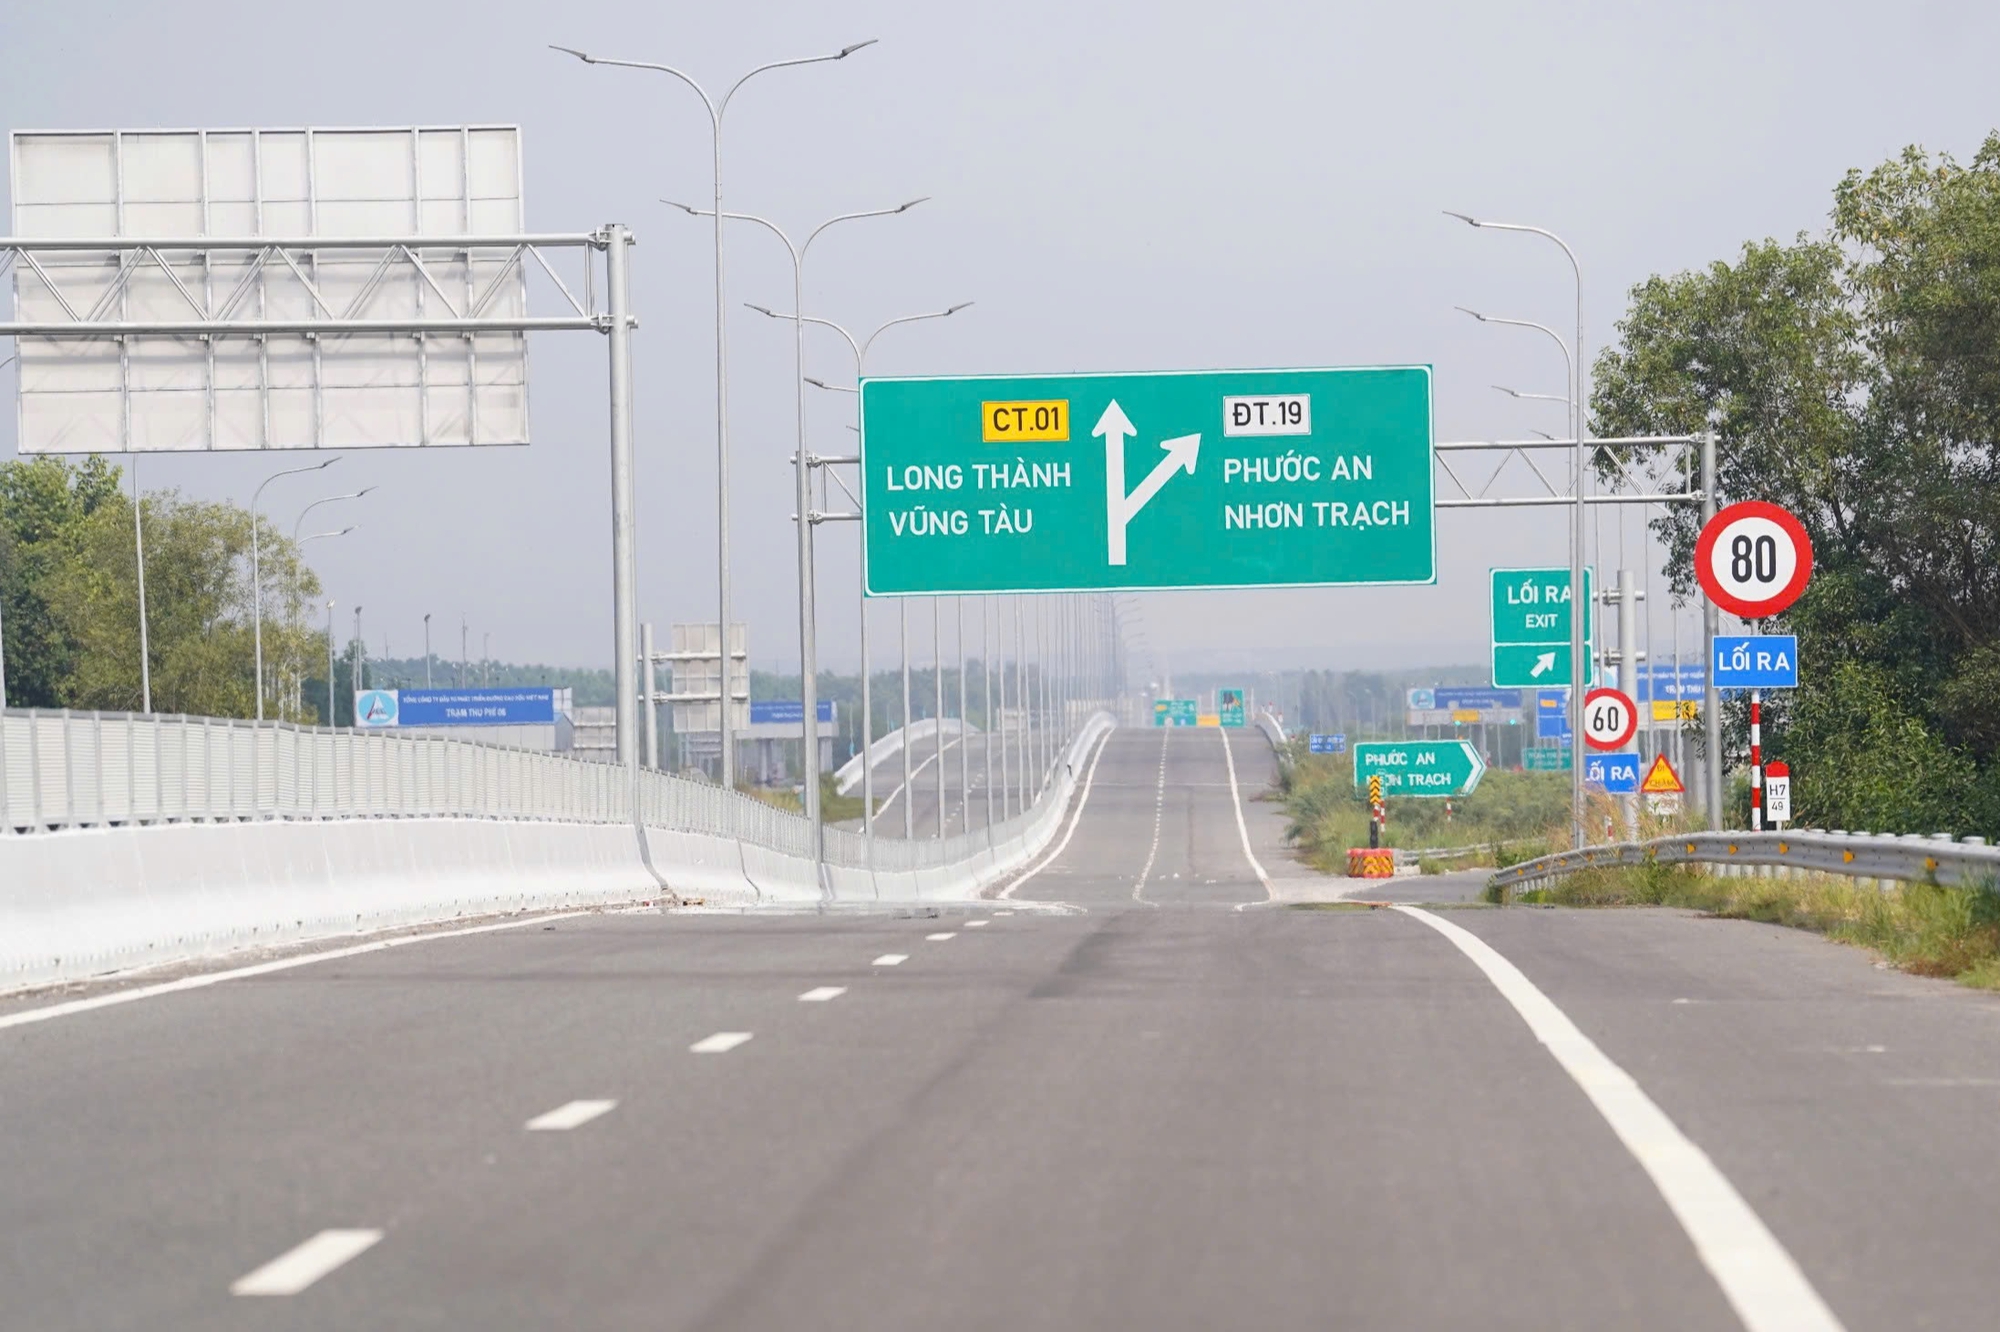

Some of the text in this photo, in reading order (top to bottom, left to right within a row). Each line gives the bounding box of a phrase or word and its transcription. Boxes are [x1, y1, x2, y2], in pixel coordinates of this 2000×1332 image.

[993, 407, 1059, 432] CT.01
[1232, 401, 1302, 427] ĐT.19
[886, 457, 1071, 491] LONG THÀNH
[1223, 450, 1372, 483] PHƯỚC AN
[888, 503, 1033, 536] VŨNG TÀU
[1223, 500, 1409, 531] NHƠN TRẠCH
[1732, 535, 1777, 583] 80
[1508, 579, 1571, 604] LỐI RA
[1525, 613, 1558, 628] EXIT
[1718, 642, 1790, 671] LỐI RA
[1592, 706, 1619, 732] 60
[1365, 749, 1435, 766] PHƯỚC AN
[1407, 773, 1451, 788] TRẠCH
[1611, 766, 1636, 781] RA
[1769, 784, 1786, 796] H7
[1771, 801, 1784, 811] 49
